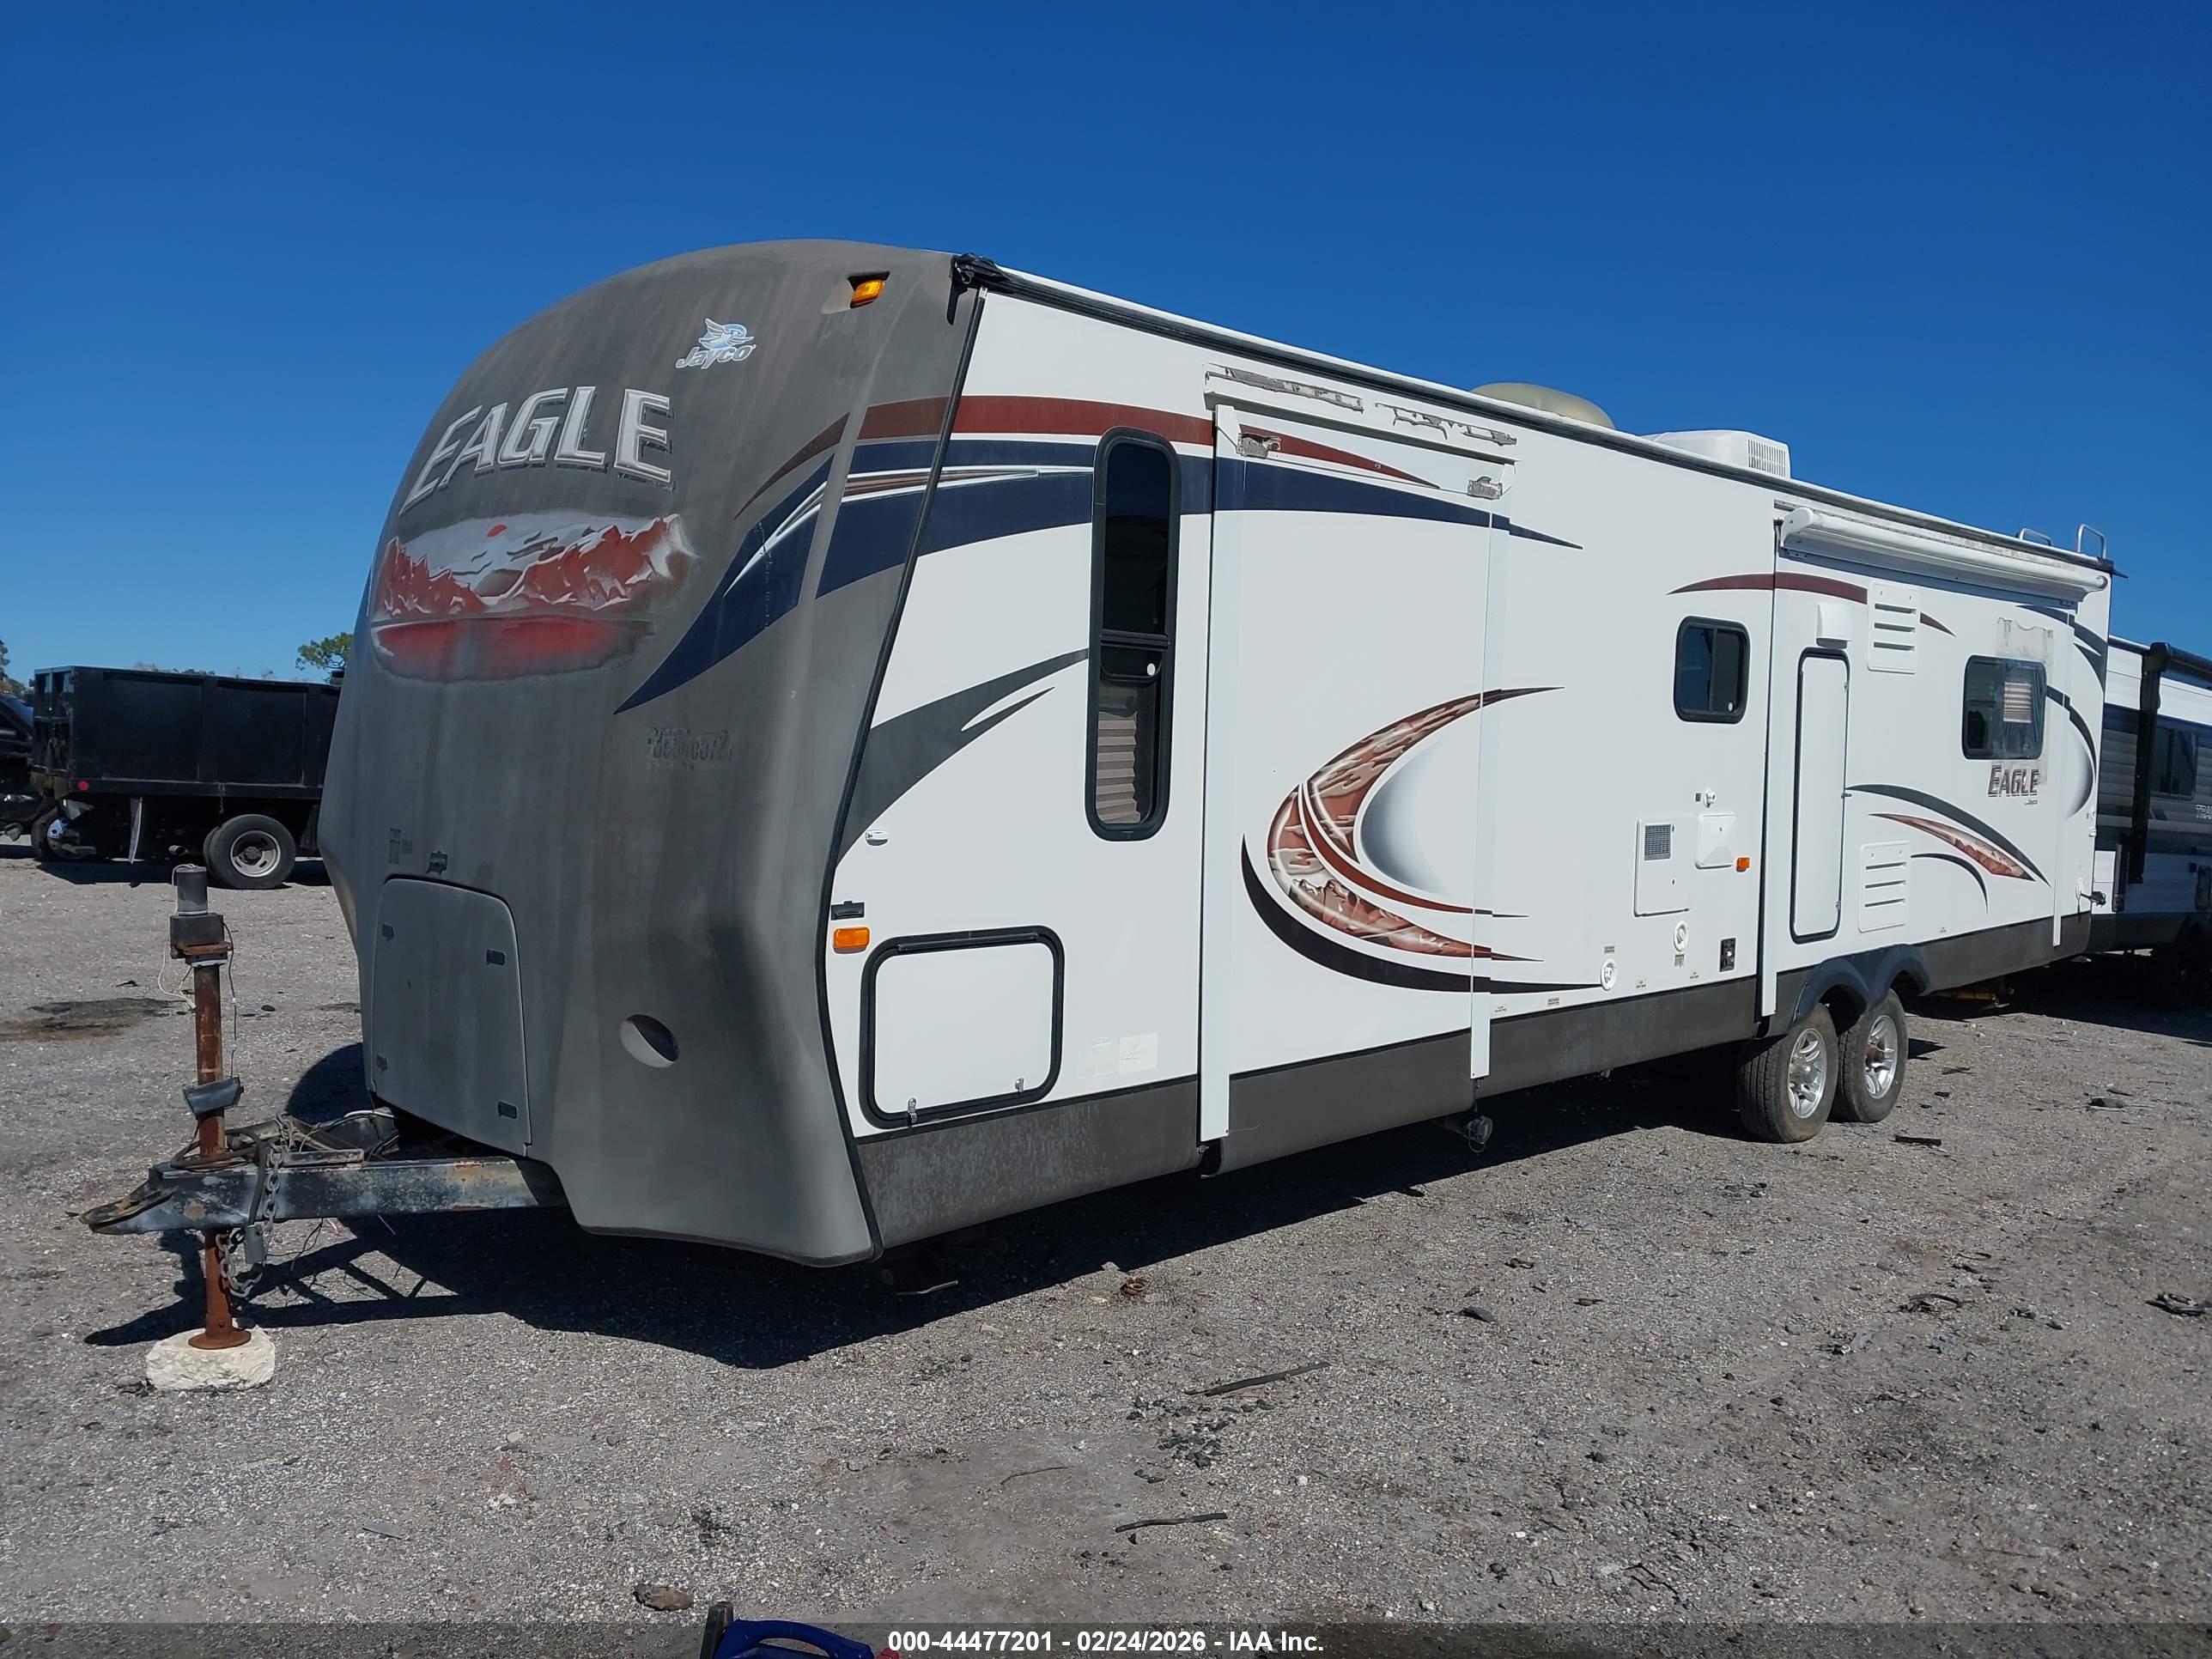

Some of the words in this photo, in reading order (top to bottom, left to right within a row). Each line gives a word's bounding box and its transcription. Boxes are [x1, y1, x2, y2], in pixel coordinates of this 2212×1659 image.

[675, 344, 757, 369] Jayco
[398, 386, 675, 517] EAGLE
[1987, 764, 2039, 797] EAGLE
